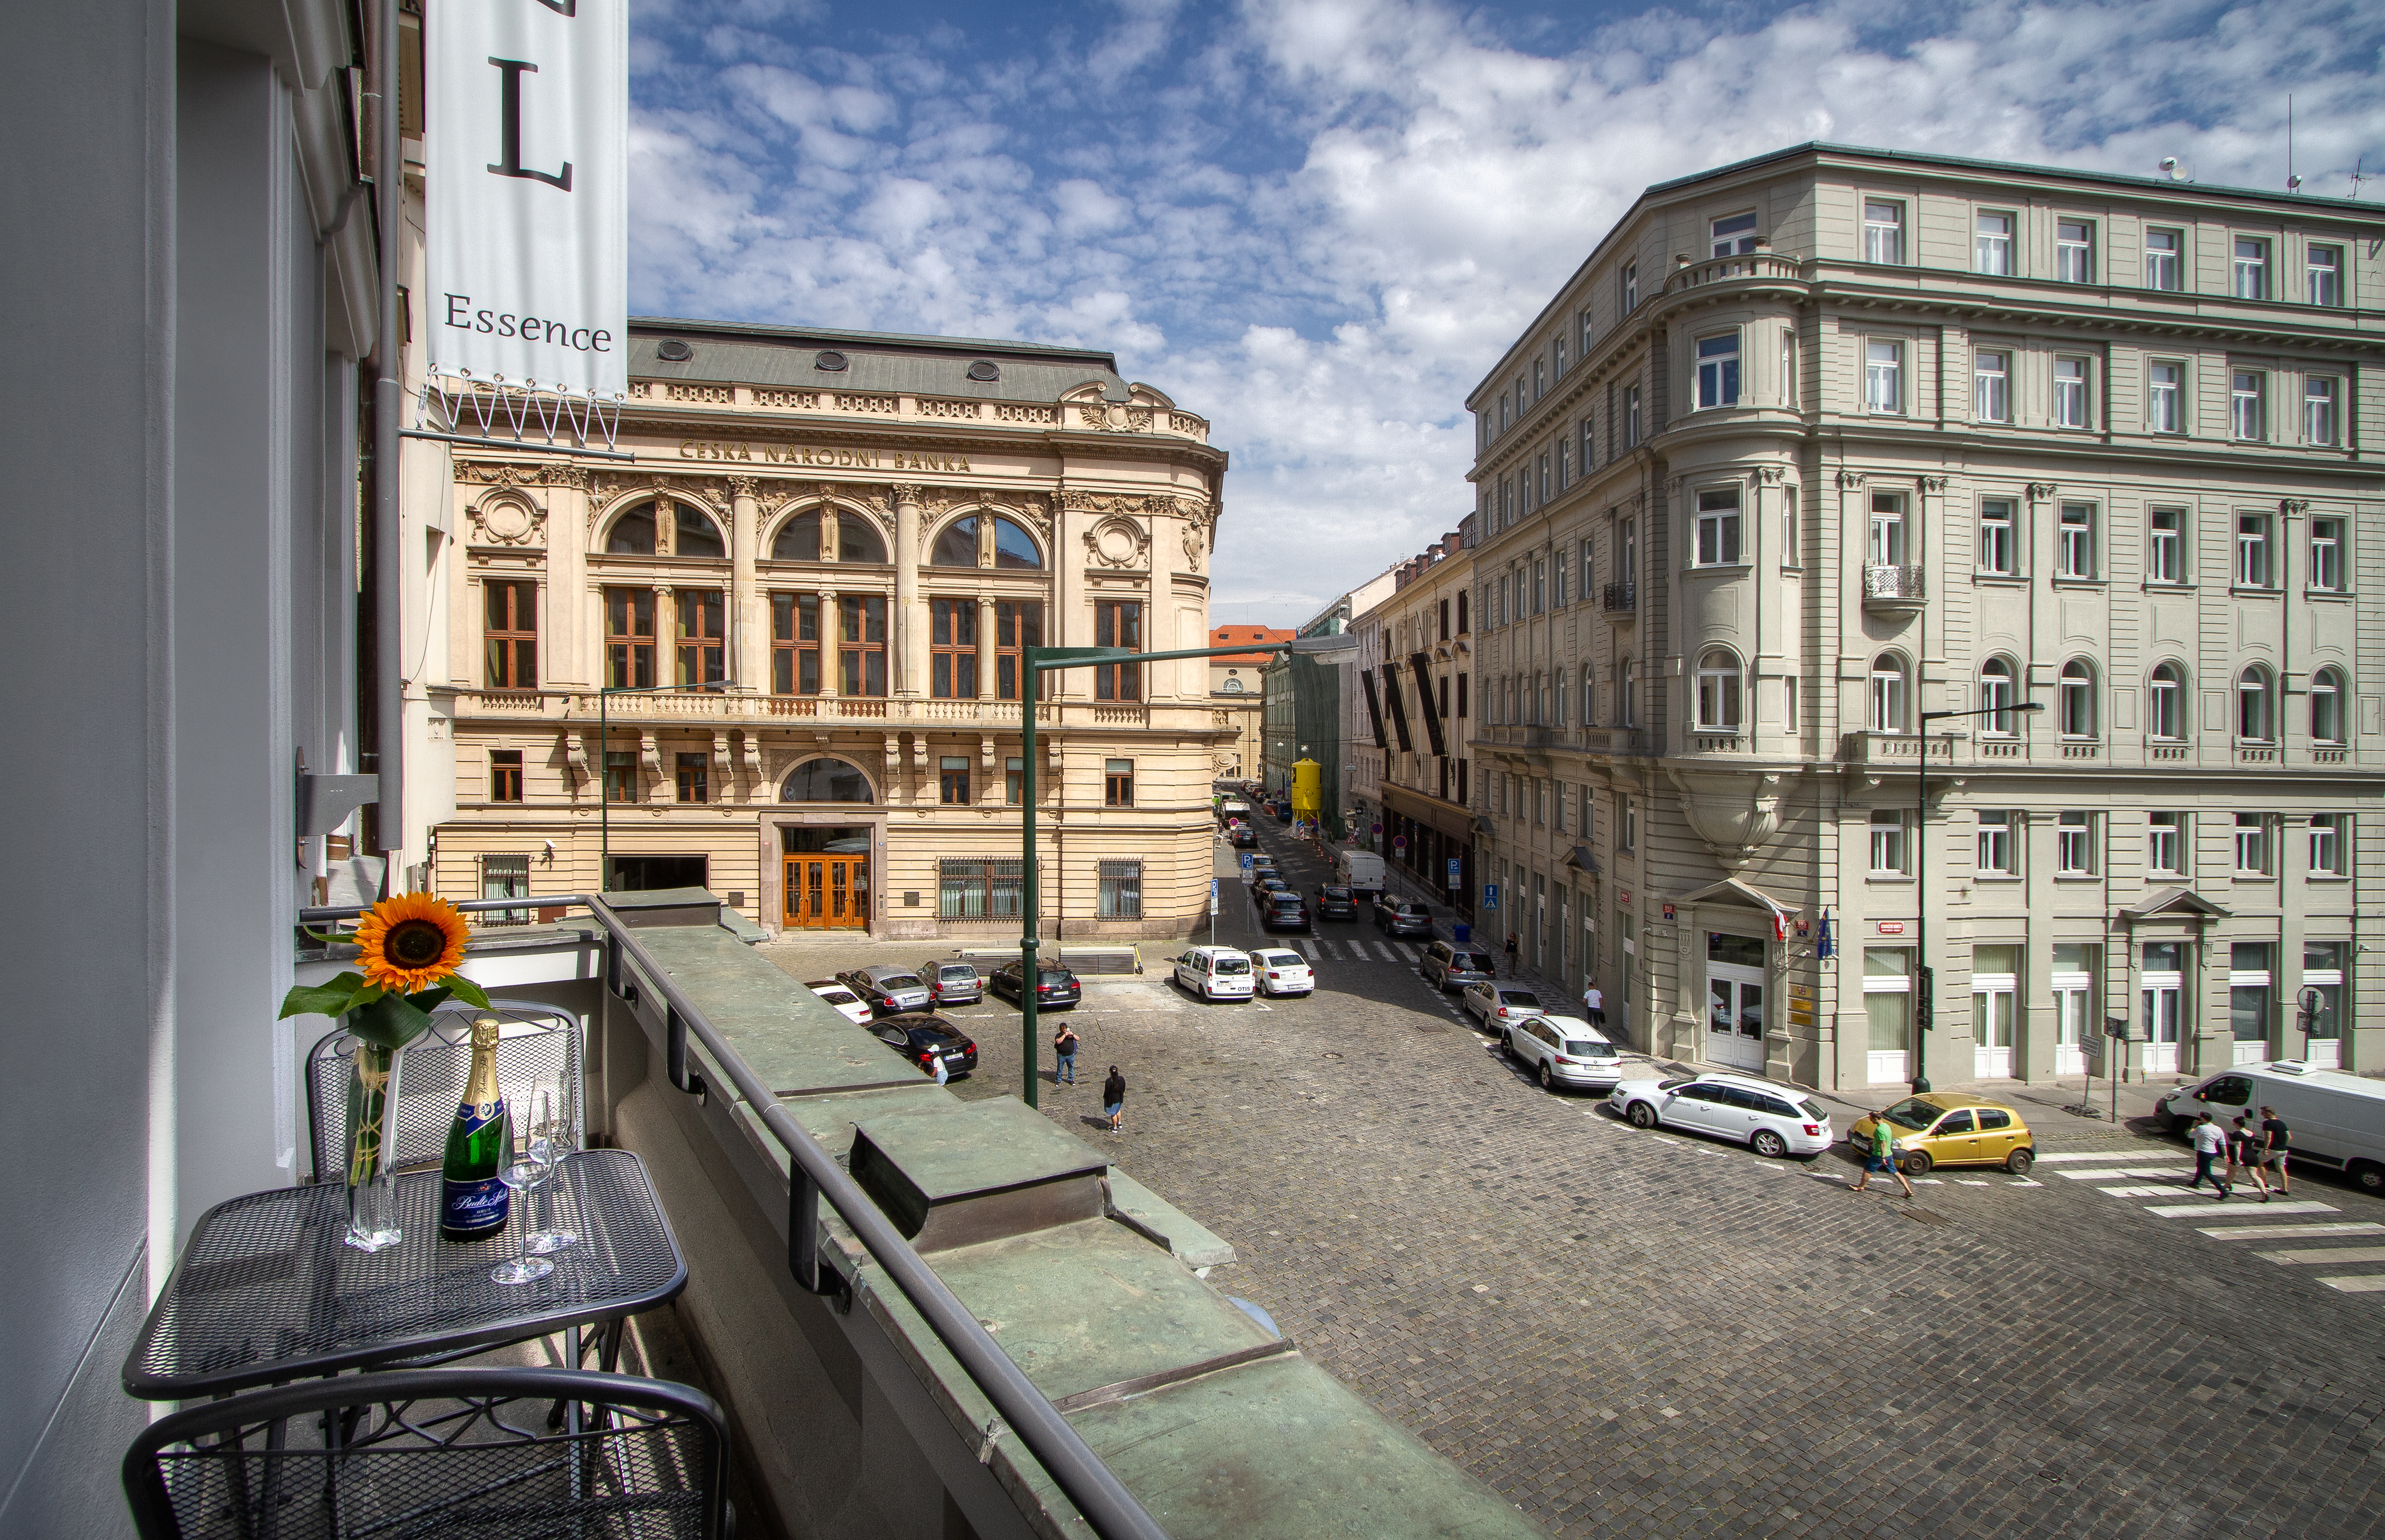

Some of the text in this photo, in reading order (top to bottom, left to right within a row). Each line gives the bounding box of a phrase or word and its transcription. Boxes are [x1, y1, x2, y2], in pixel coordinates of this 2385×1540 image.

[444, 293, 611, 353] Essence
[679, 438, 972, 472] ČESKÁ NÁRODNÍ BANKA
[1374, 720, 1386, 744] BOHO
[1397, 721, 1410, 747] BOHO
[1429, 719, 1442, 750] BOHO
[1244, 855, 1250, 864] P
[1451, 861, 1458, 869] P
